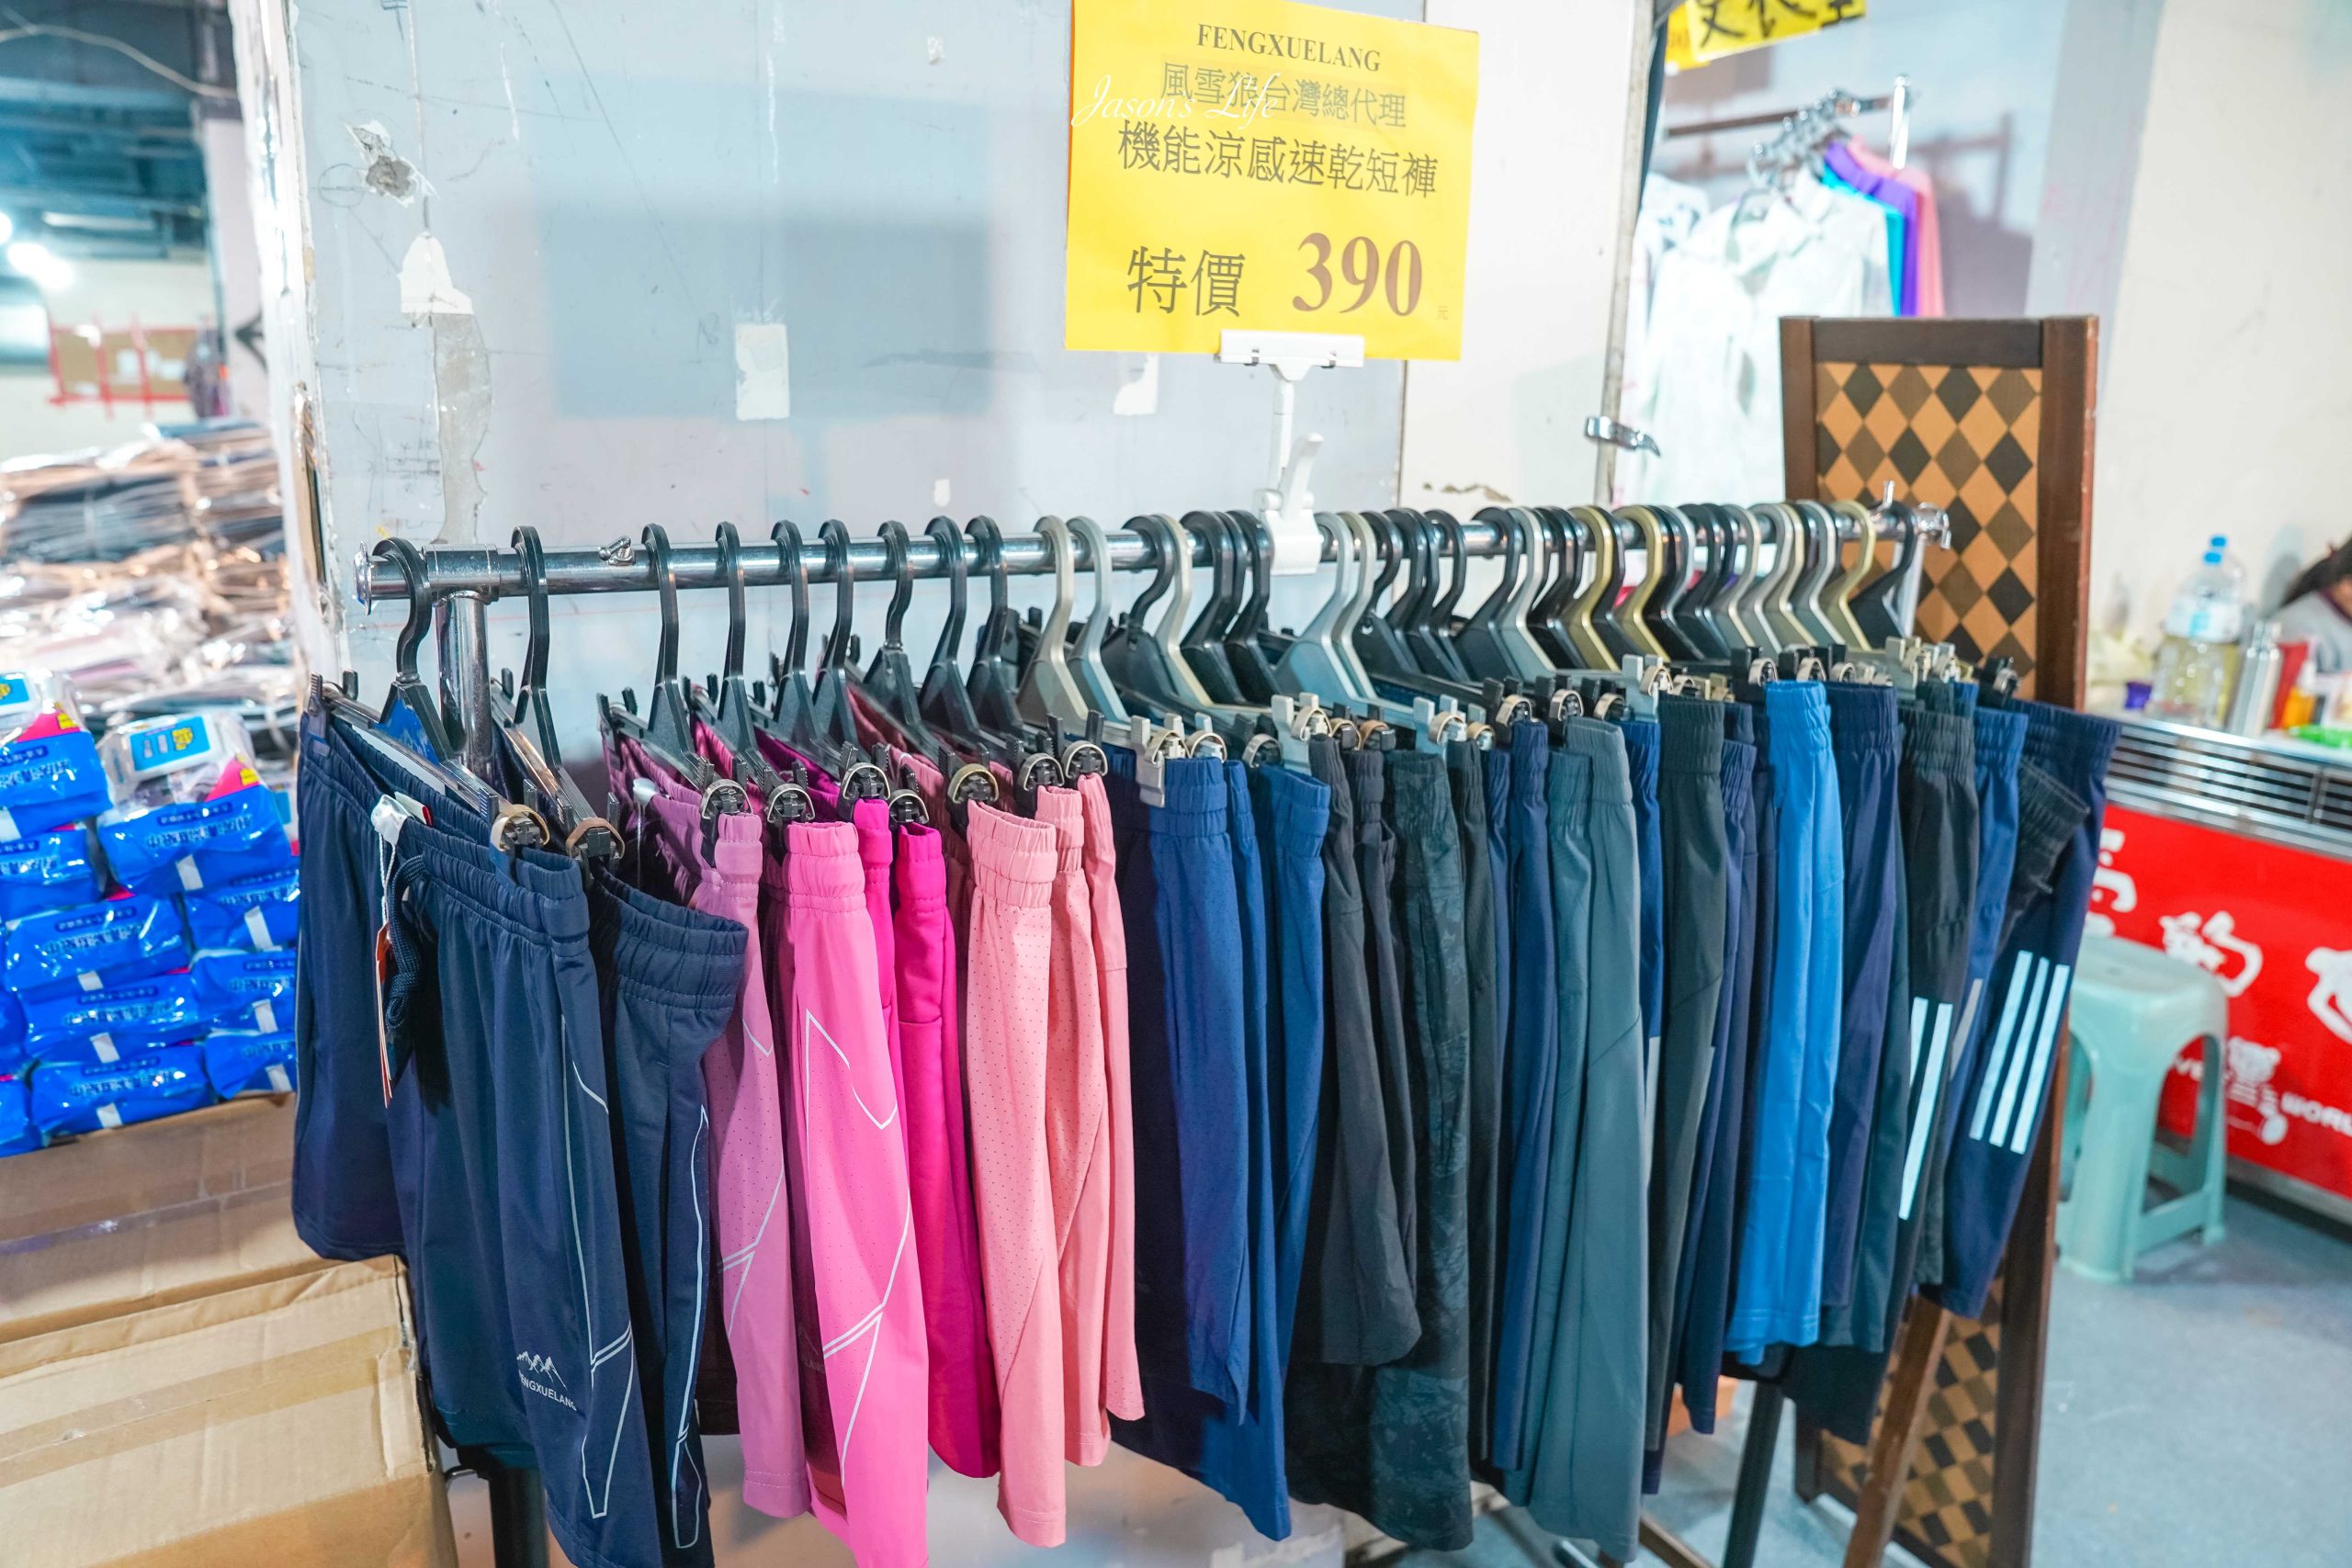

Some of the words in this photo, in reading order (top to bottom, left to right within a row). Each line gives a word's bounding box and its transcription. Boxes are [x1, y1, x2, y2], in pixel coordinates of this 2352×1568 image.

[1197, 23, 1381, 73] FENGXUELANG
[1117, 118, 1439, 198] 機能涼感速乾短褲
[1126, 245, 1246, 318] 特價
[1292, 231, 1423, 317] 390
